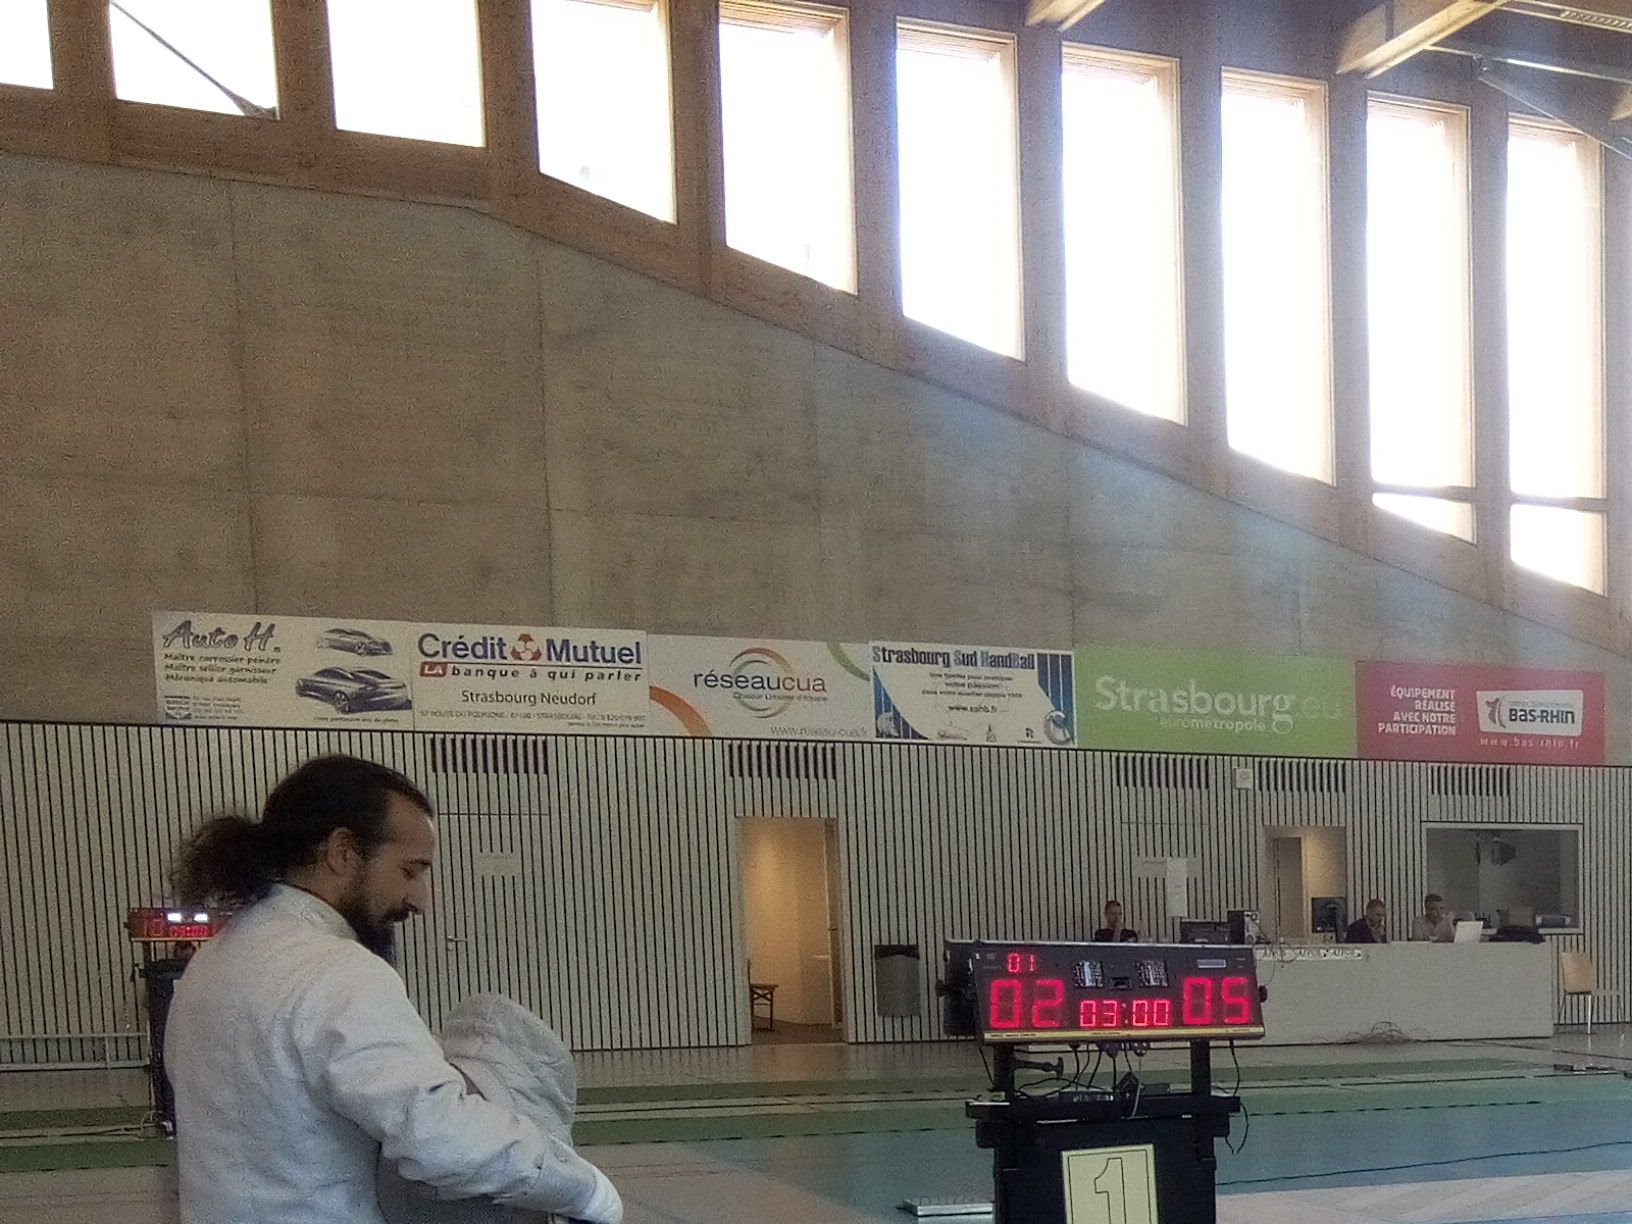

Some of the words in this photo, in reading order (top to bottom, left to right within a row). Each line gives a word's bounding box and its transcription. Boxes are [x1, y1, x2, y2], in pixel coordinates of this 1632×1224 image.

[162, 620, 238, 649] Auto
[417, 633, 508, 661] Crédit
[545, 637, 643, 665] Mutuel
[873, 646, 949, 668] Strasbourg
[953, 651, 977, 667] Sud
[423, 664, 443, 675] LA
[451, 665, 520, 680] banque
[529, 668, 538, 679] à
[547, 670, 576, 681] qui
[584, 671, 643, 682] parler
[693, 669, 827, 693] réseaucua
[461, 689, 537, 707] Strasbourg
[540, 691, 596, 706] Neudorf
[1390, 685, 1456, 700] ÉQUIPEMENT
[1095, 676, 1295, 734] Strasbourg
[1378, 722, 1456, 736] PARTICIPATION
[1393, 711, 1421, 722] AVEC
[1422, 712, 1456, 724] NOTRE
[990, 979, 1065, 1028] 02
[1181, 976, 1251, 1025] 05
[1079, 999, 1170, 1027] 03:00
